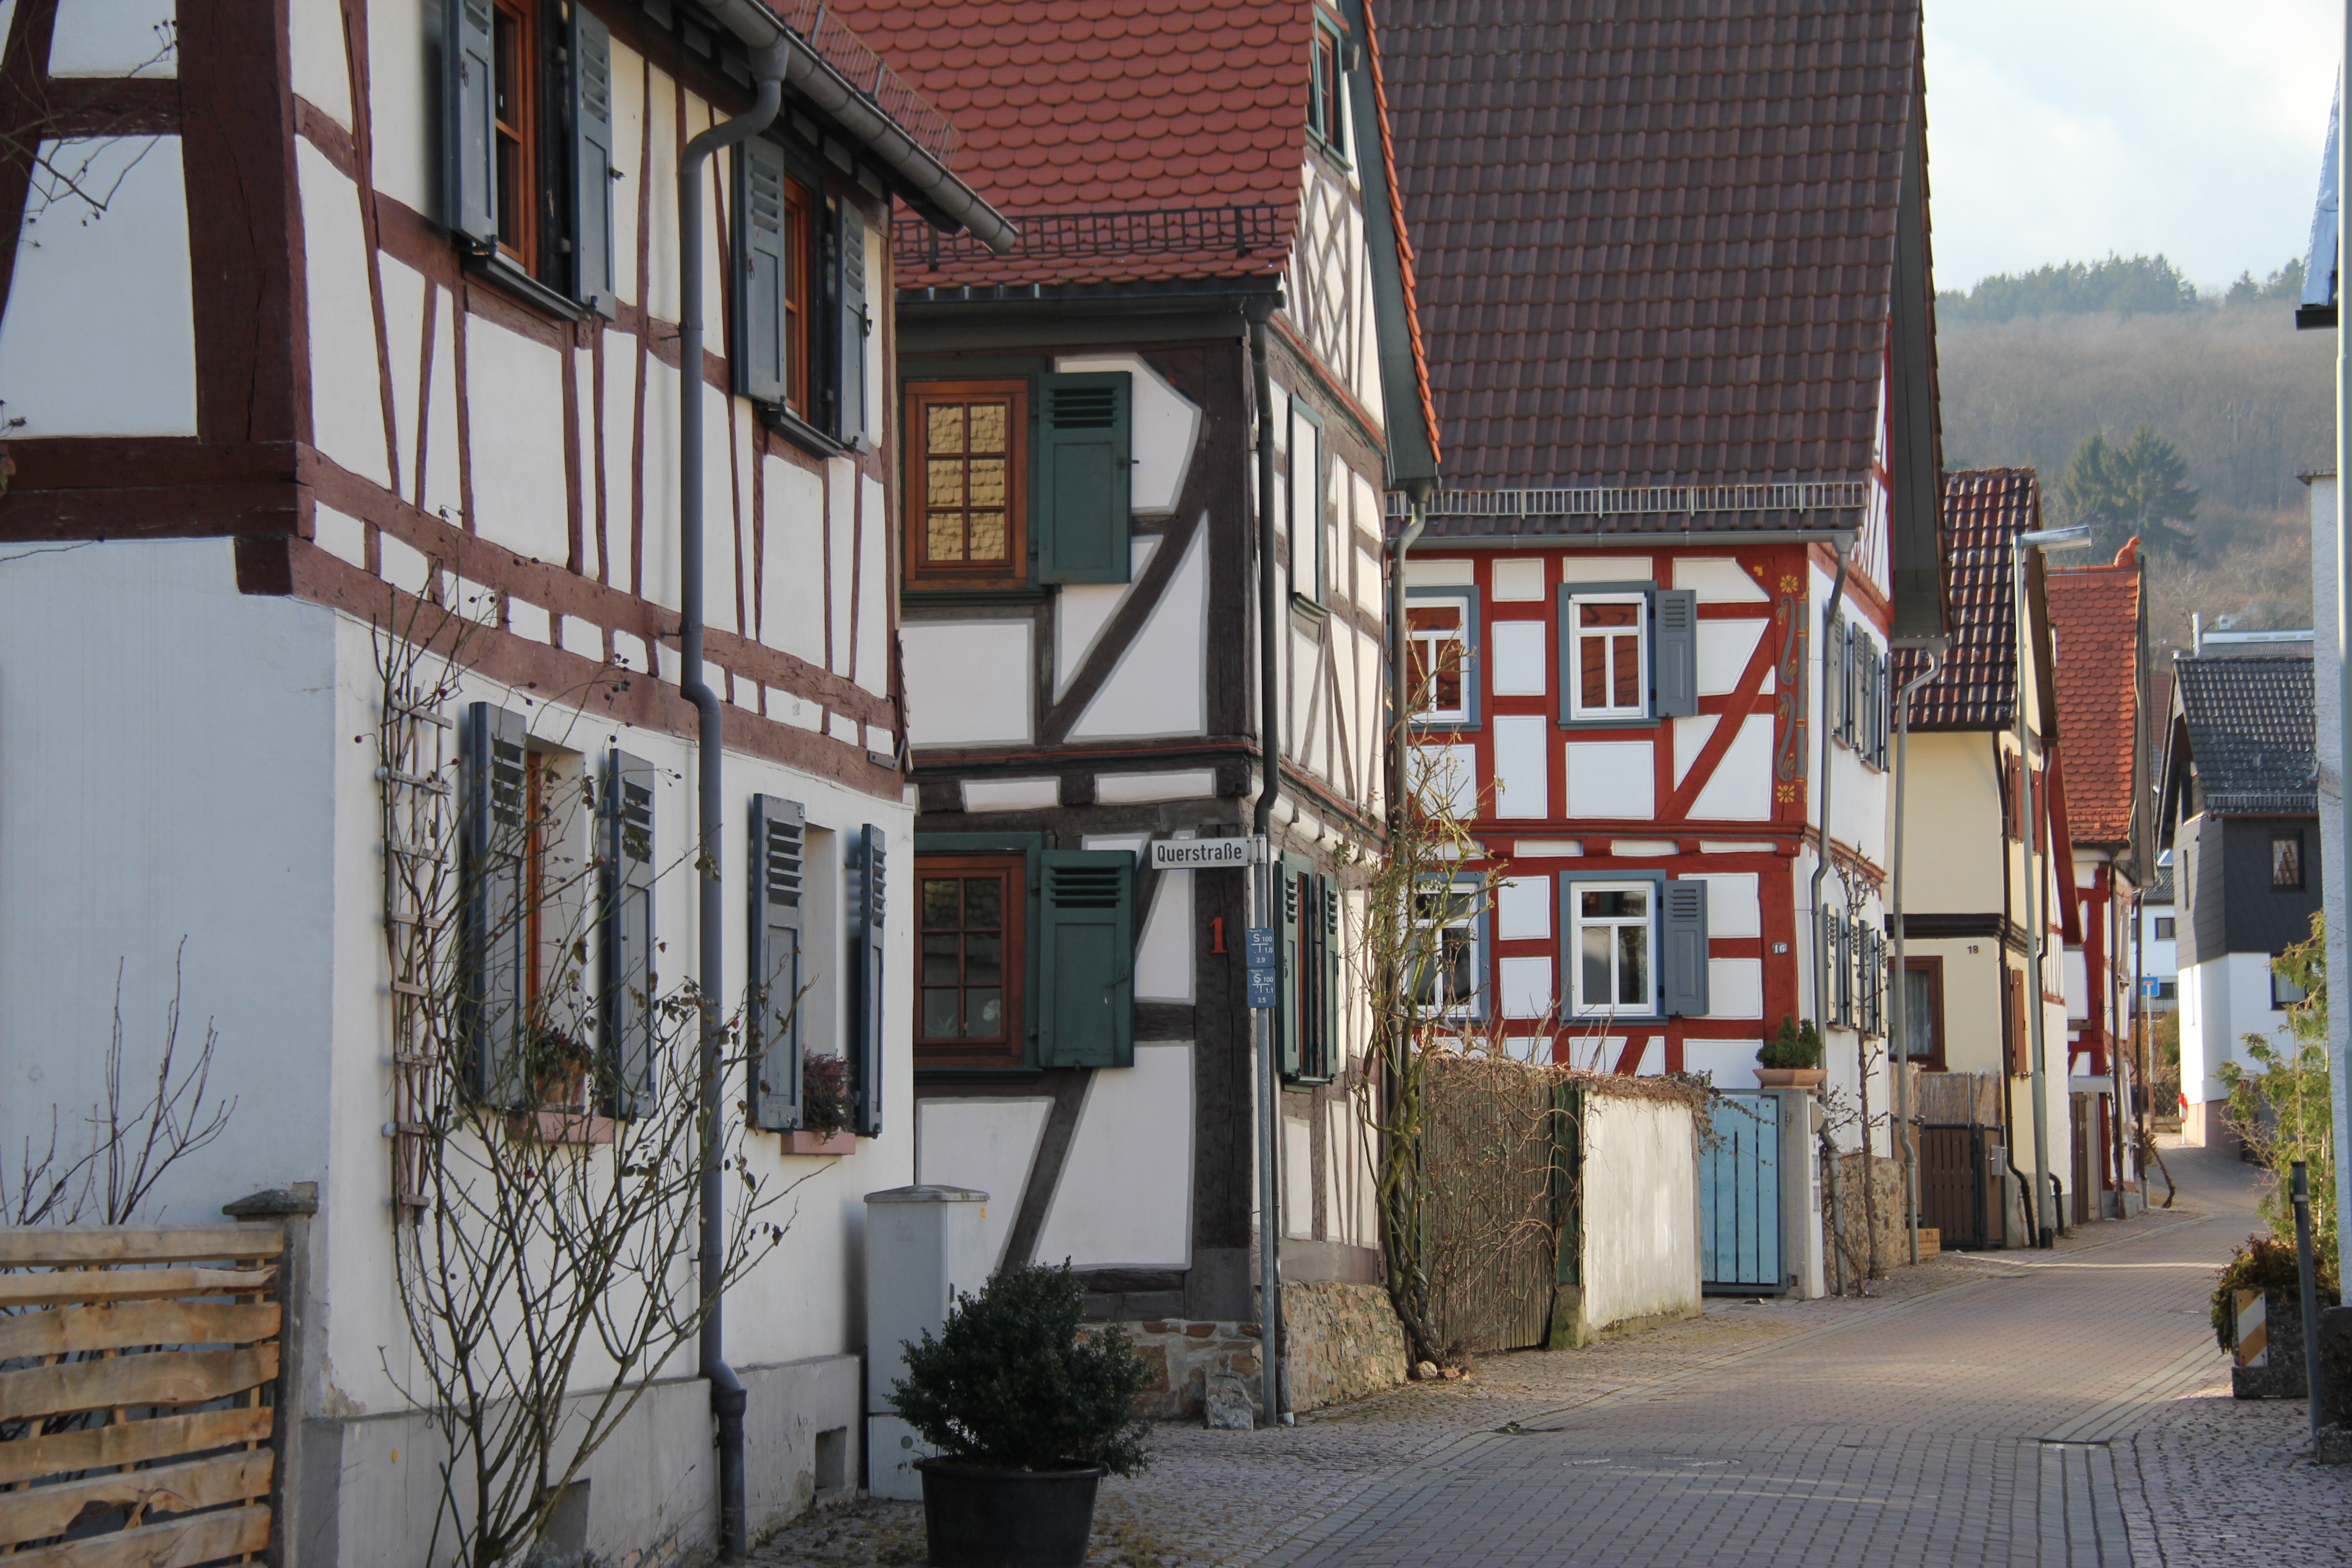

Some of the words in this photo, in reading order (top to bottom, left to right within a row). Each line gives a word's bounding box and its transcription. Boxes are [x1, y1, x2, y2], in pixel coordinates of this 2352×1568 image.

[1157, 843, 1242, 862] Querstraße
[1209, 917, 1227, 953] 1
[1253, 933, 1260, 942] S
[1774, 944, 1785, 953] 16
[1967, 945, 1979, 954] 18
[1254, 974, 1261, 983] S
